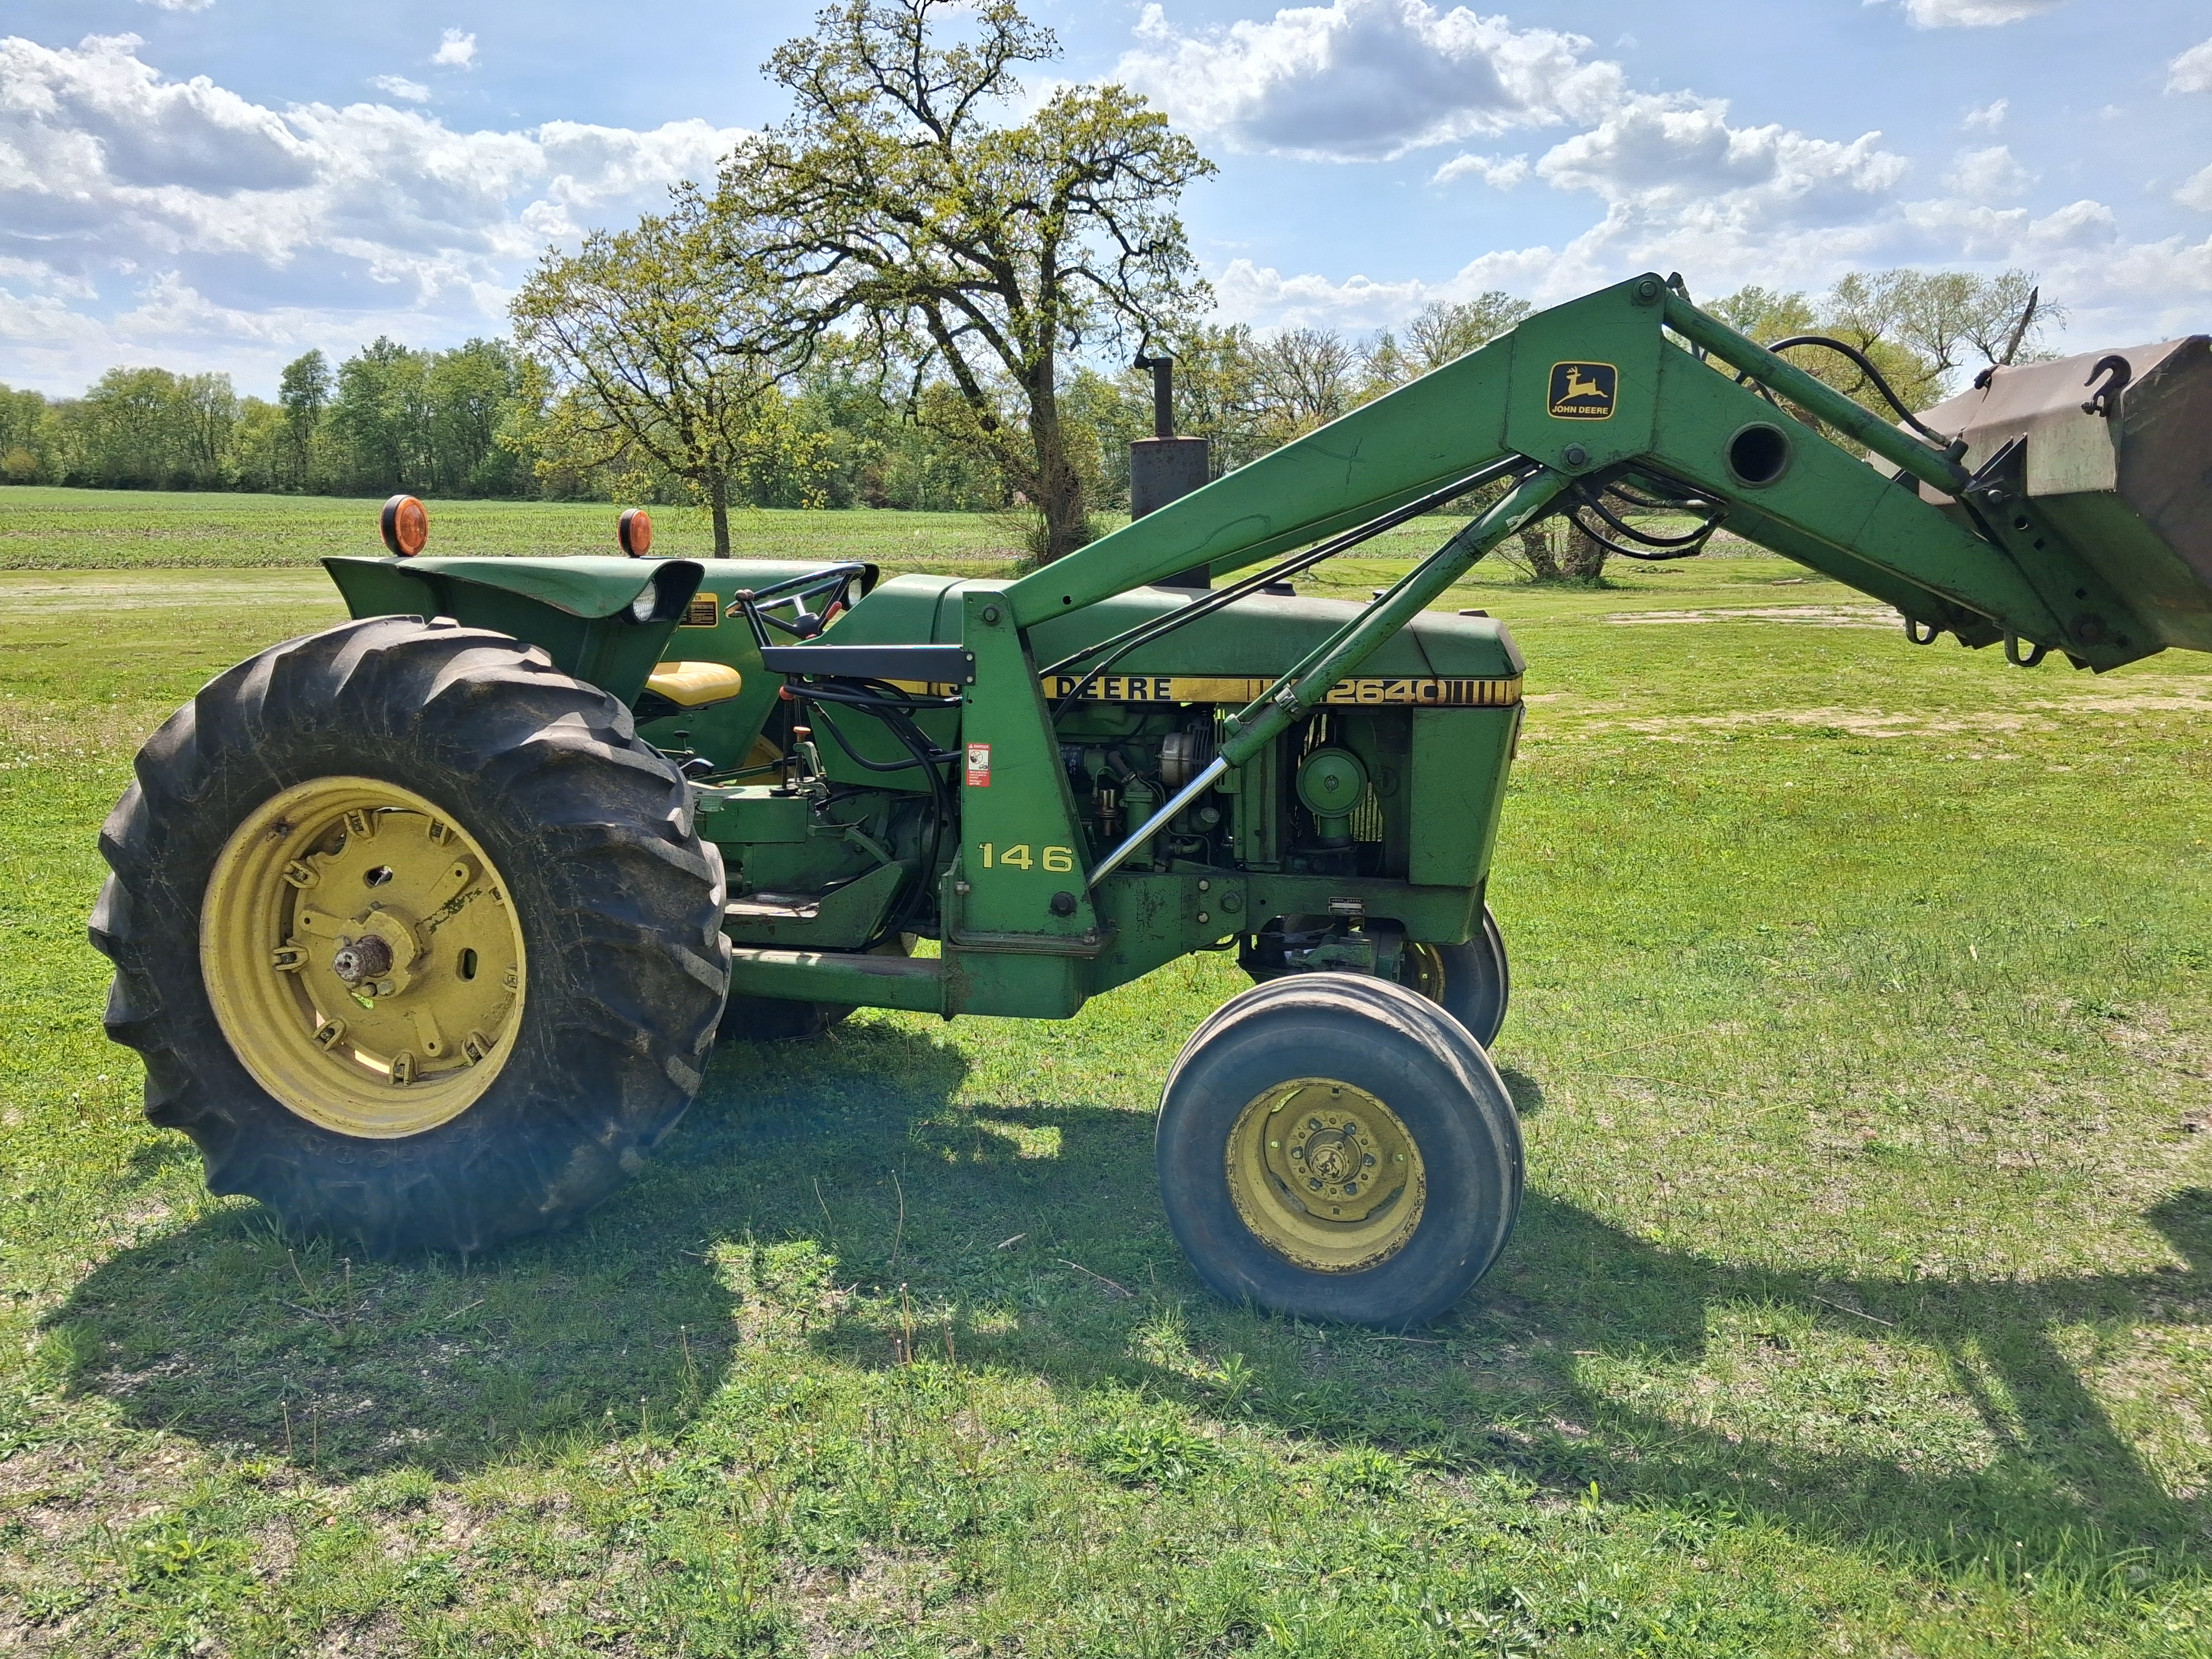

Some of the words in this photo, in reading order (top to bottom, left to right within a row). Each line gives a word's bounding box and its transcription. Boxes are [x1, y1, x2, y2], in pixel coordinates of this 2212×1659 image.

[1578, 407, 1609, 415] DEERE
[1056, 677, 1171, 700] DEERE
[1326, 679, 1446, 704] 2640
[978, 841, 1073, 873] 146
